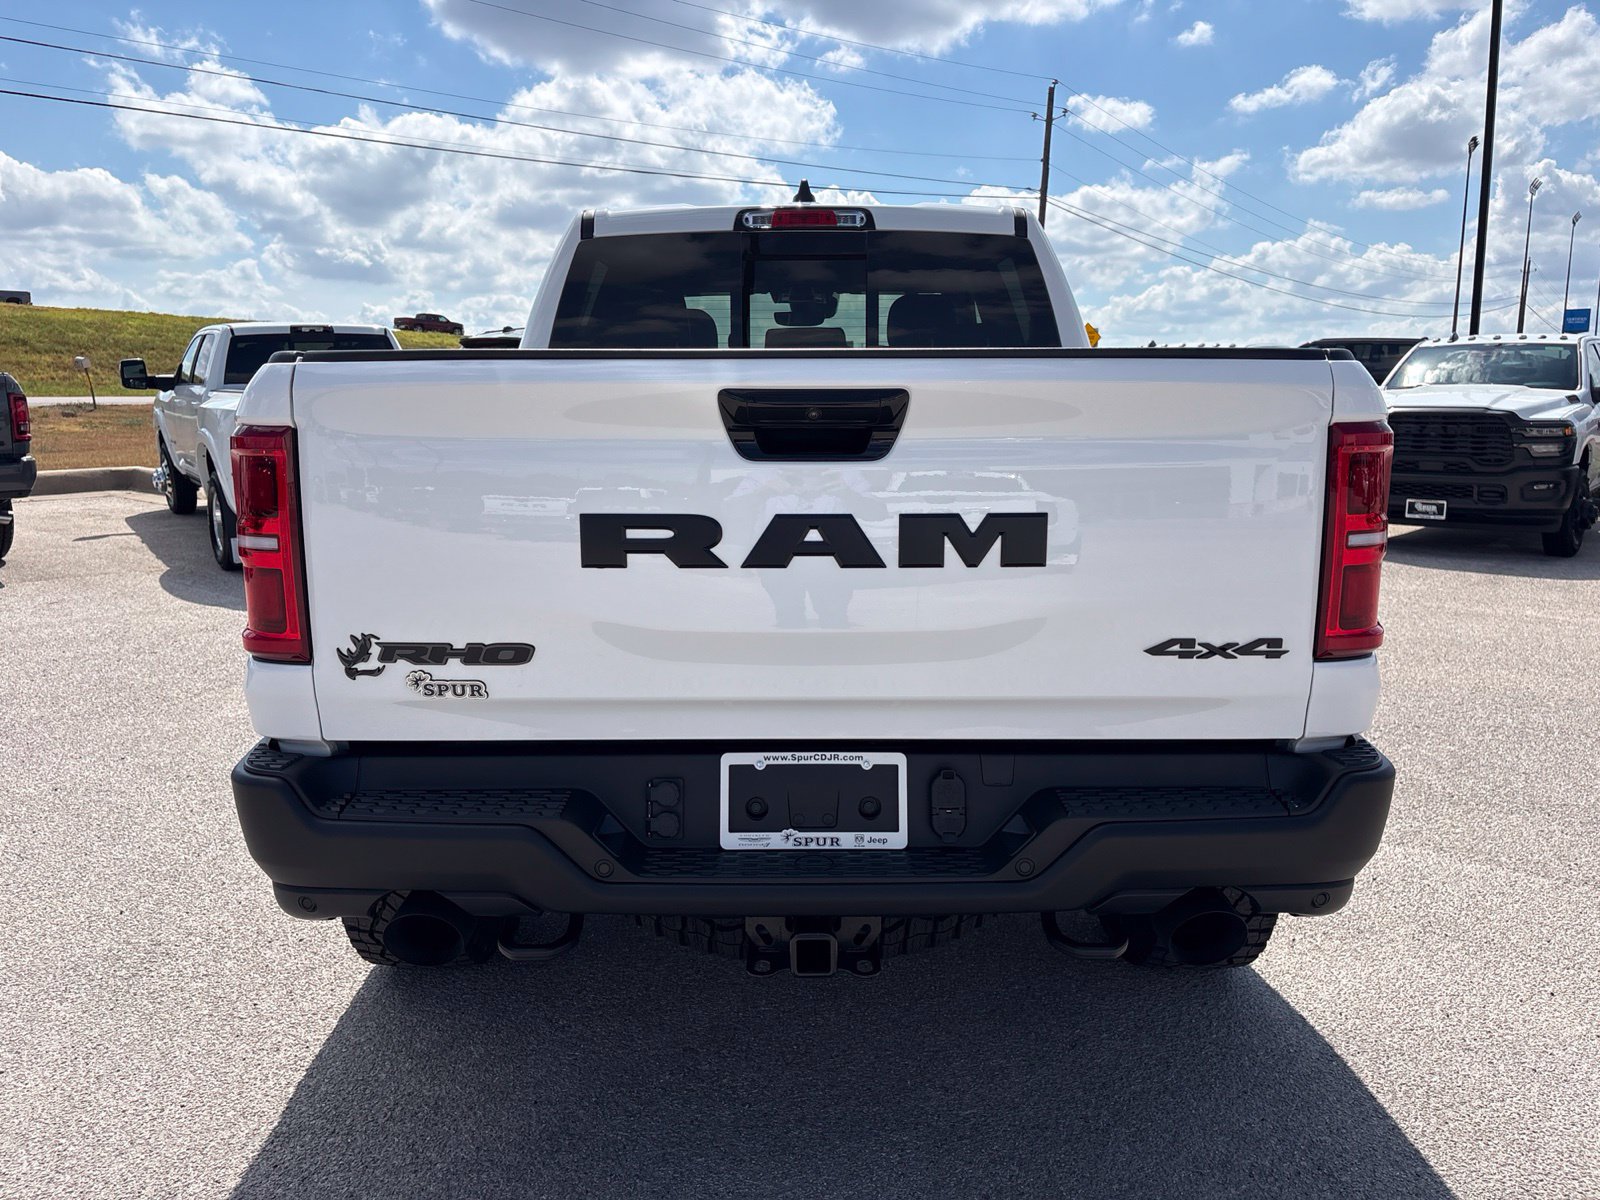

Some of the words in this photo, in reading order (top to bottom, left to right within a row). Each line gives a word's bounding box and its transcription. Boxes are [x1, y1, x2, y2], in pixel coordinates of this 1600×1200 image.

[580, 513, 1048, 569] RAM
[375, 642, 535, 666] RHO
[1143, 637, 1290, 660] 4x4
[423, 683, 484, 697] SPUR
[763, 753, 864, 763] www.SpurCDJR.com
[793, 836, 841, 847] SPUR
[867, 836, 888, 845] Jeep
